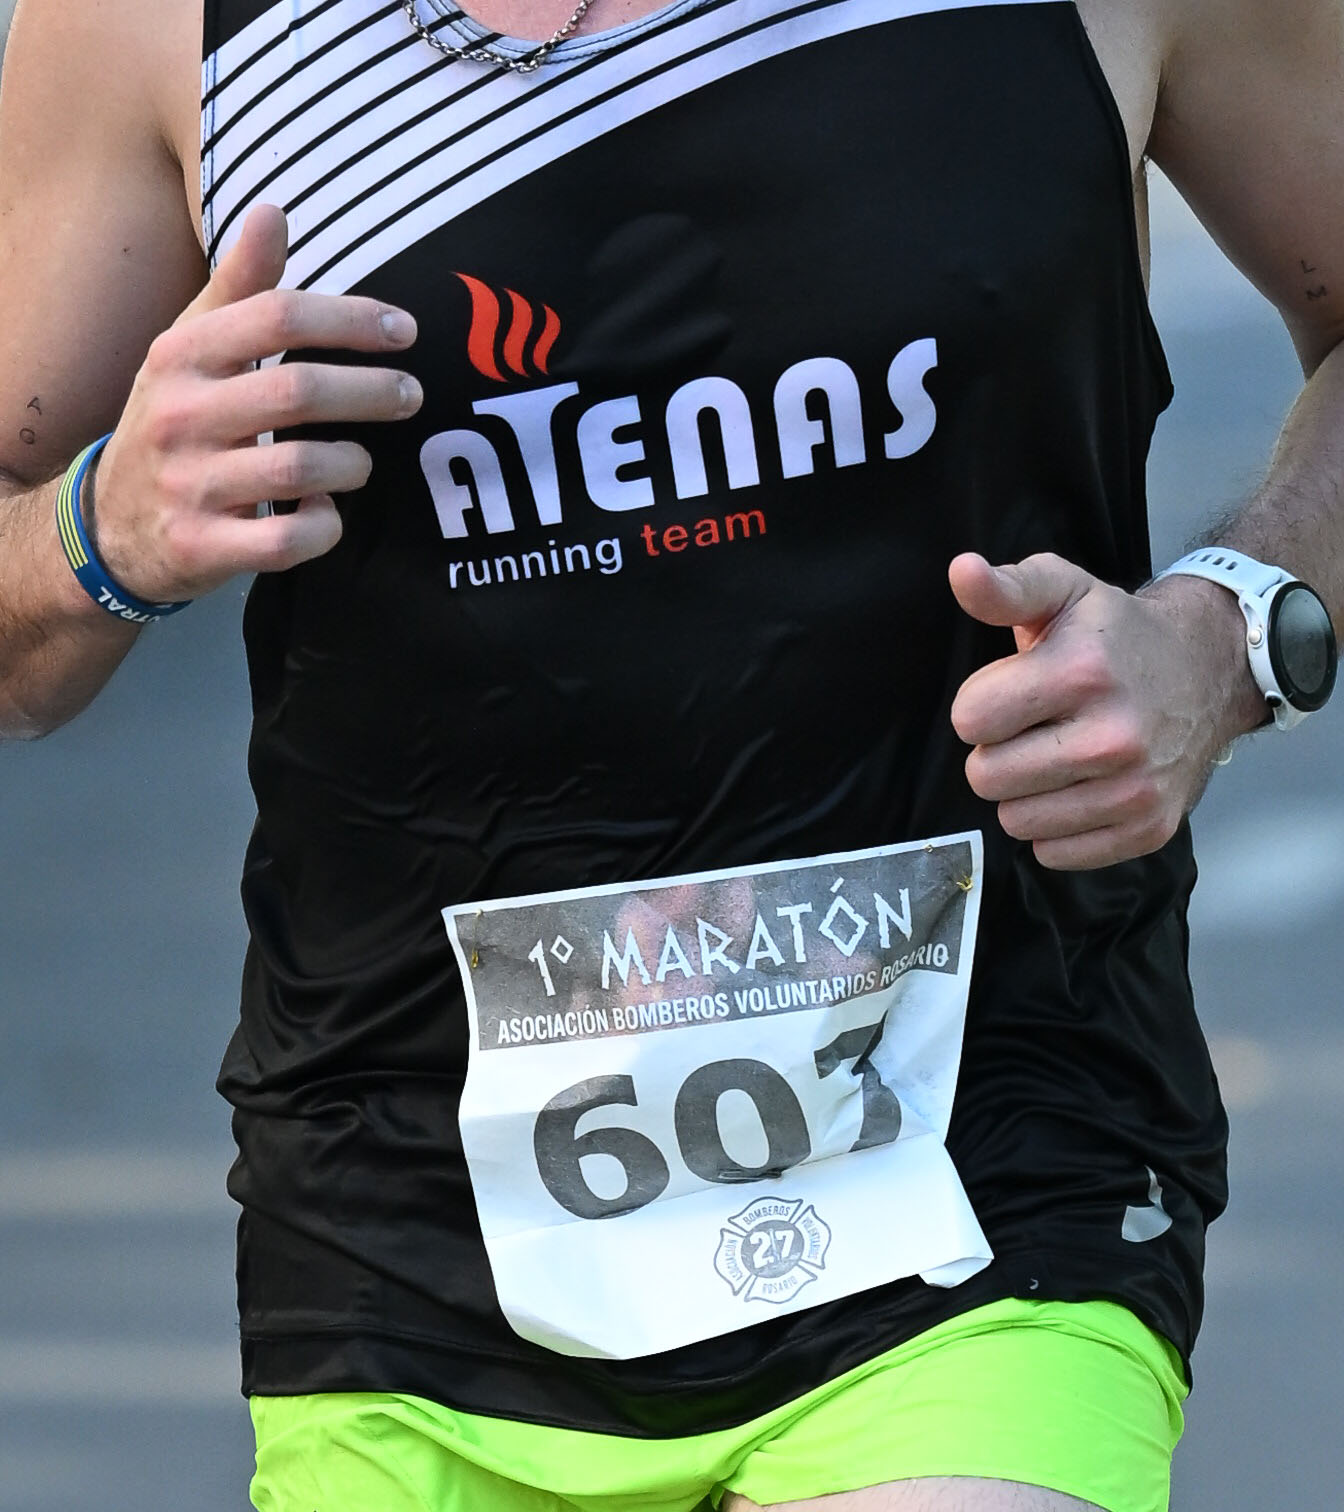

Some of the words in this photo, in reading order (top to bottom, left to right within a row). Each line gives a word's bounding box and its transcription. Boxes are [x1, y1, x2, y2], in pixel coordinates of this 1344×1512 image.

[449, 537, 623, 589] running
[641, 509, 766, 557] team
[601, 876, 913, 990] MARATÓN
[498, 1004, 609, 1044] ASOCIACIÓN
[613, 992, 730, 1031] BOMBEROS
[734, 970, 877, 1015] VOLUNTARIOS
[880, 943, 949, 988] ROSARIO
[533, 1008, 902, 1221] 607
[749, 1228, 795, 1269] 27
